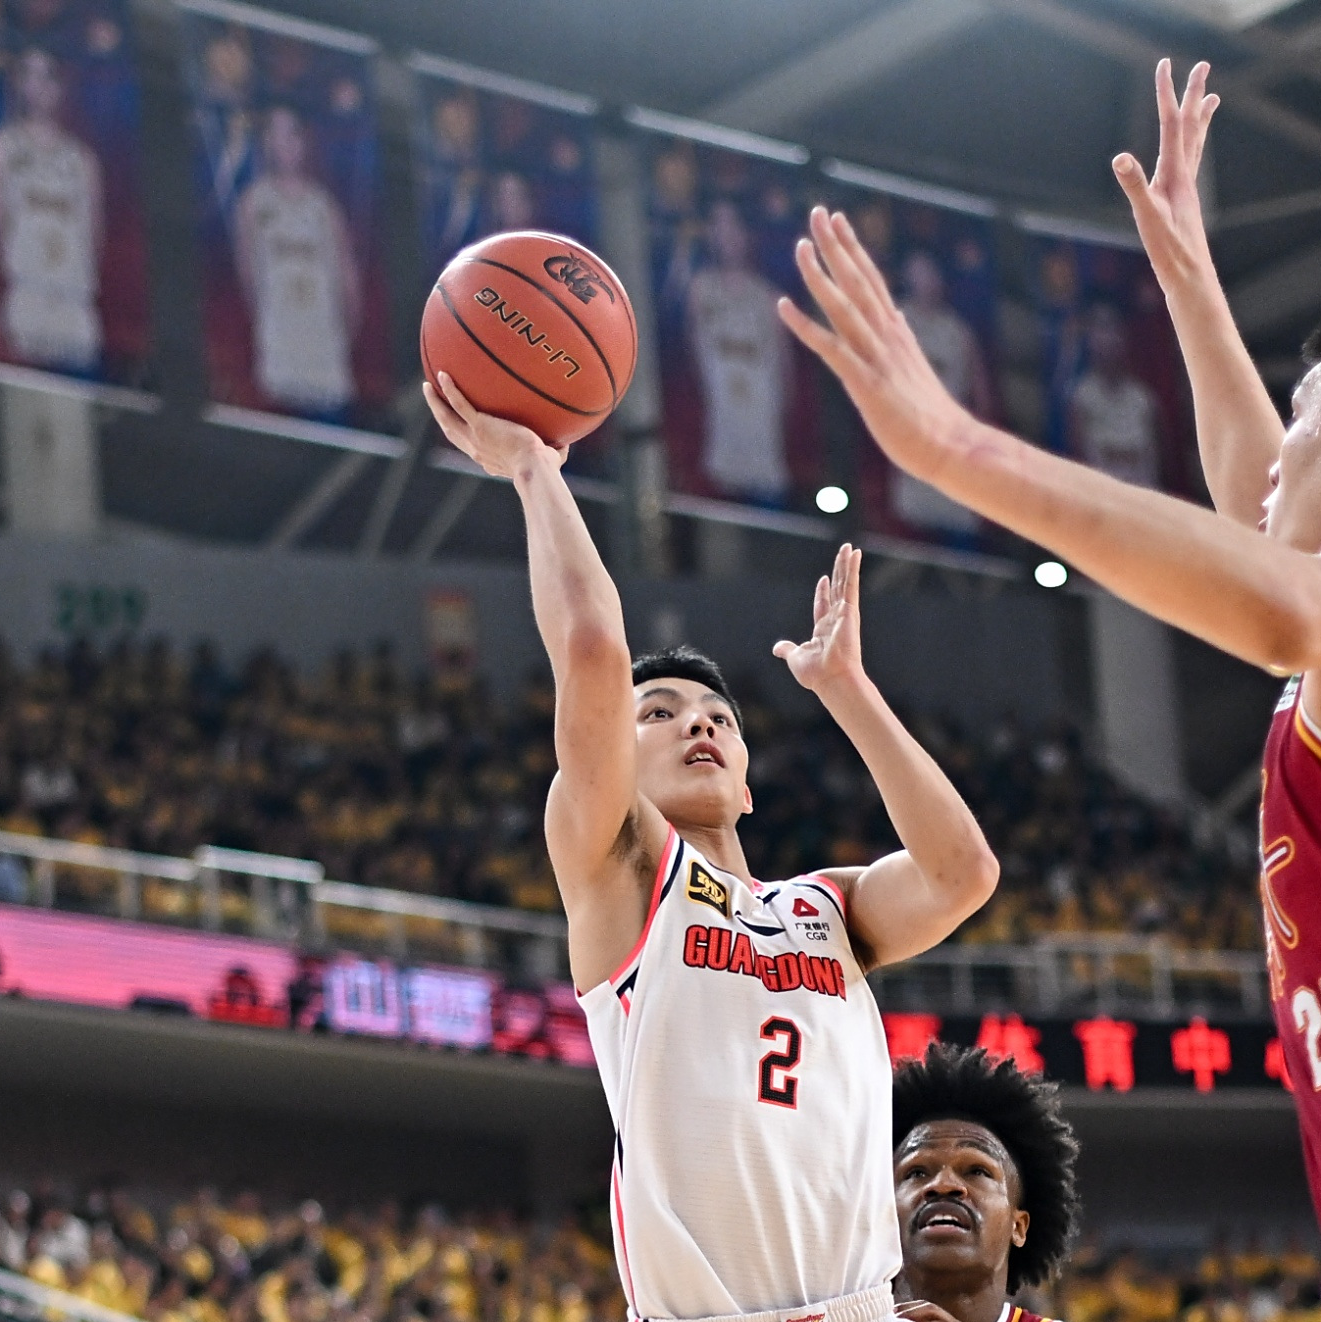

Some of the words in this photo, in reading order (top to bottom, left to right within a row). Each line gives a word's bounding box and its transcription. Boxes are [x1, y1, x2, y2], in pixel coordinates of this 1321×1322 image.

[474, 285, 582, 379] LI-NING
[806, 931, 828, 941] CGB
[758, 1015, 802, 1110] 2
